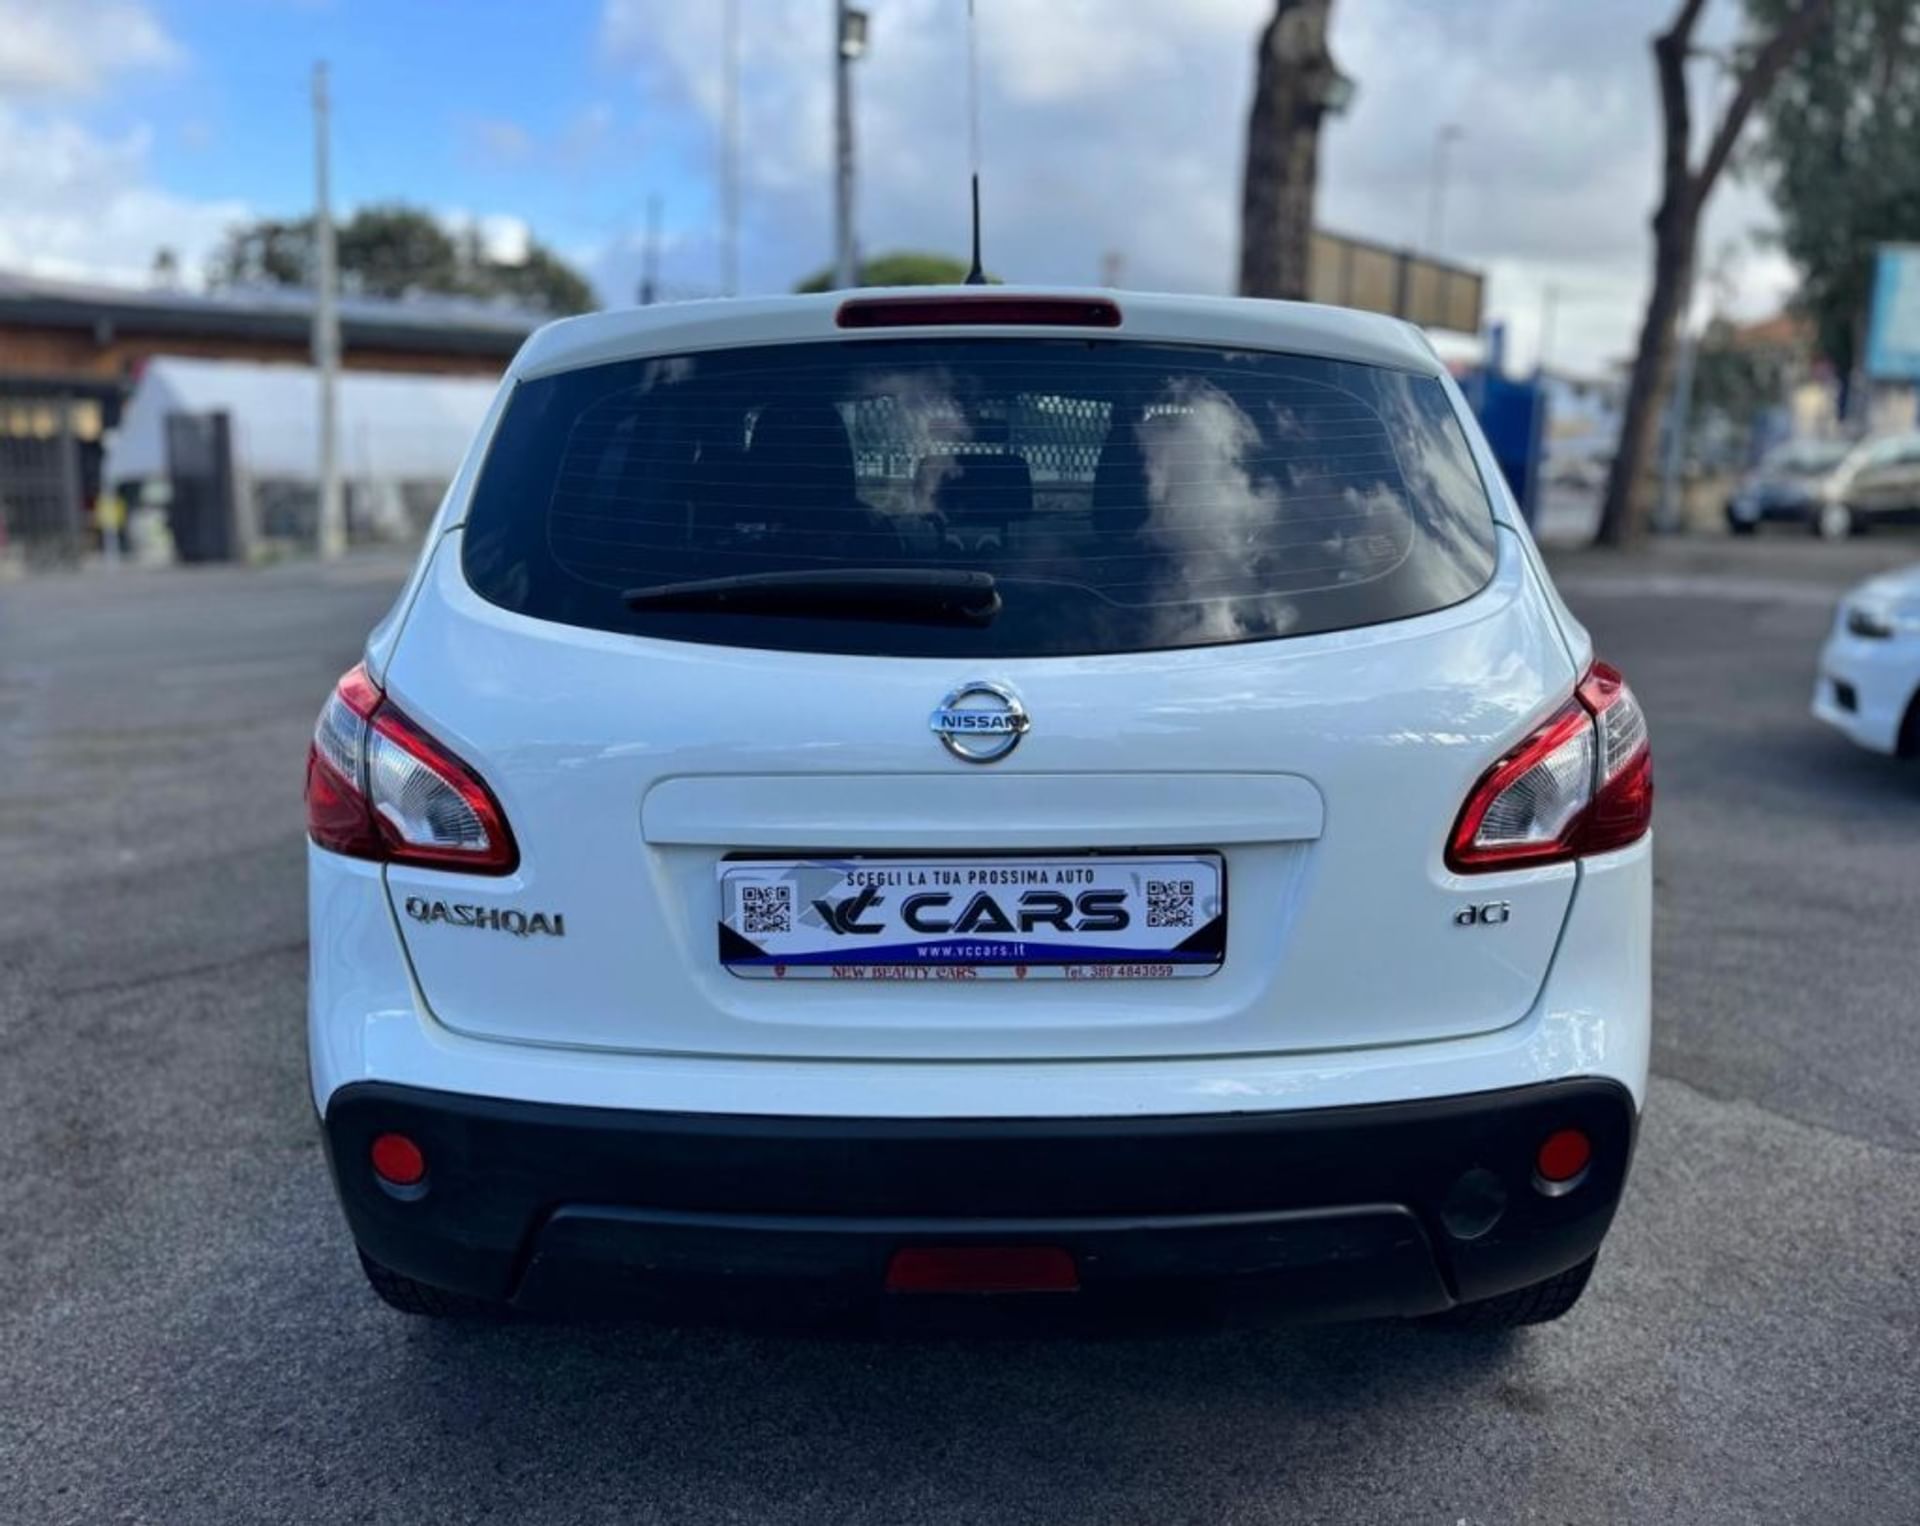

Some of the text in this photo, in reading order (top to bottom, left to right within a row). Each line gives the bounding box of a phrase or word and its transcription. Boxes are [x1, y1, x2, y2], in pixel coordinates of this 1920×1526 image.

[941, 714, 1020, 728] NISSAN
[847, 869, 1094, 886] SCEGLI LA TUA PROSSIMA AUTO
[405, 896, 565, 937] QASHQAI
[901, 890, 1130, 933] CARS
[1455, 901, 1511, 926] dCi
[917, 943, 1025, 957] www.vccars.it
[832, 965, 977, 979] NEW BEAUTY CARS
